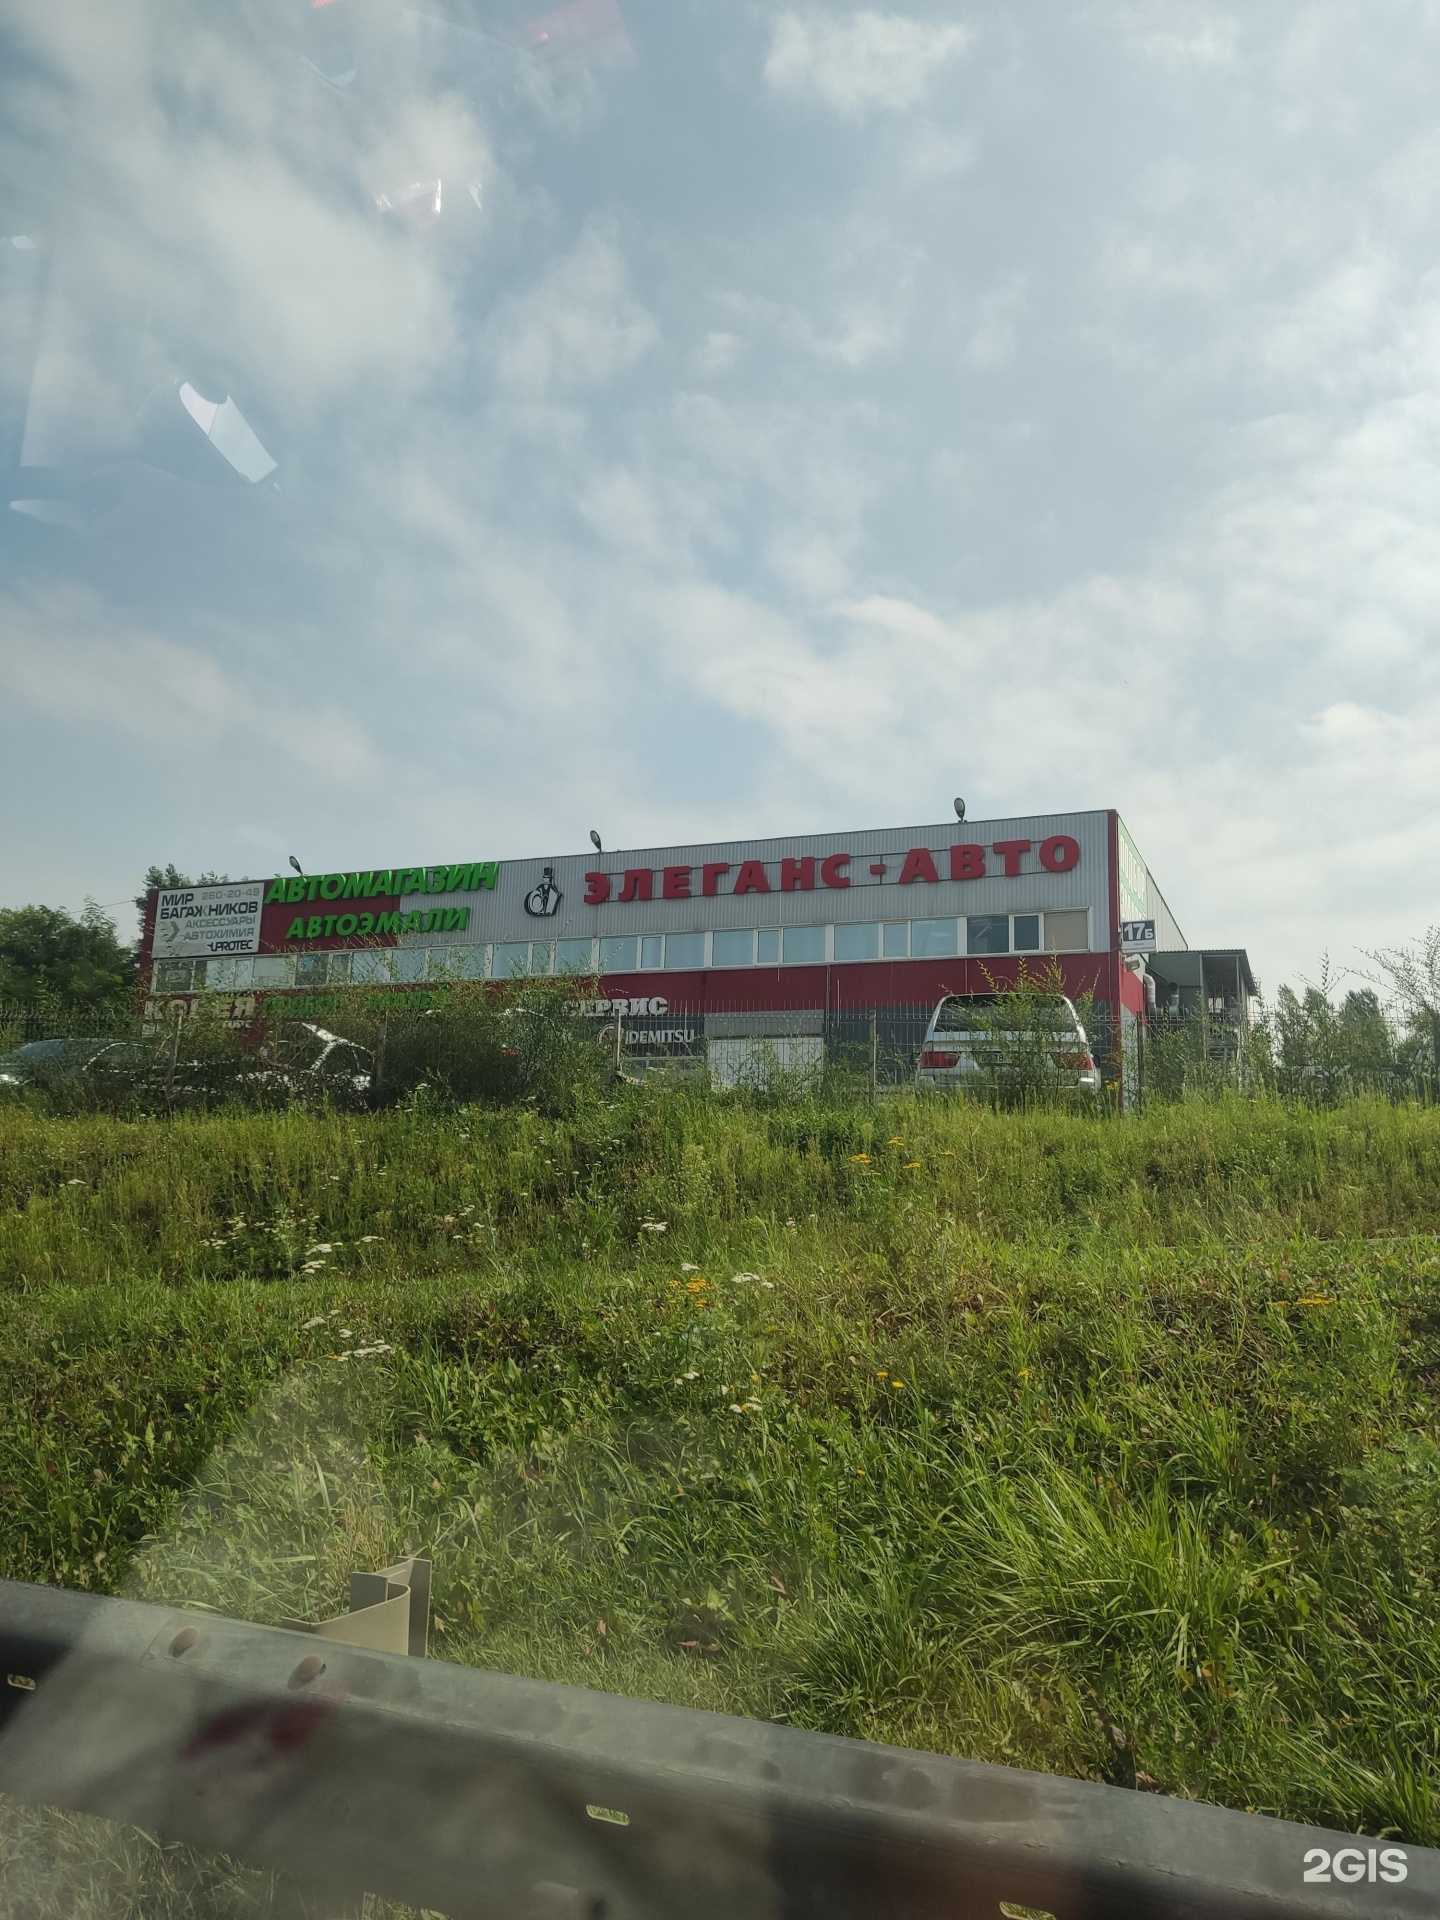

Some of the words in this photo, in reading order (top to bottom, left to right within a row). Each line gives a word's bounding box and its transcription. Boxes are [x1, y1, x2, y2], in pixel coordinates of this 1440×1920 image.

[263, 861, 499, 905] АВТОМАГАЗИН
[161, 893, 194, 907] МИР
[160, 901, 258, 919] БАГАЖНИКОВ
[286, 906, 471, 939] АВТОЭМАЛИ
[183, 927, 255, 941] АВТОХИМИЯ
[624, 1029, 696, 1045] IDEMITSU
